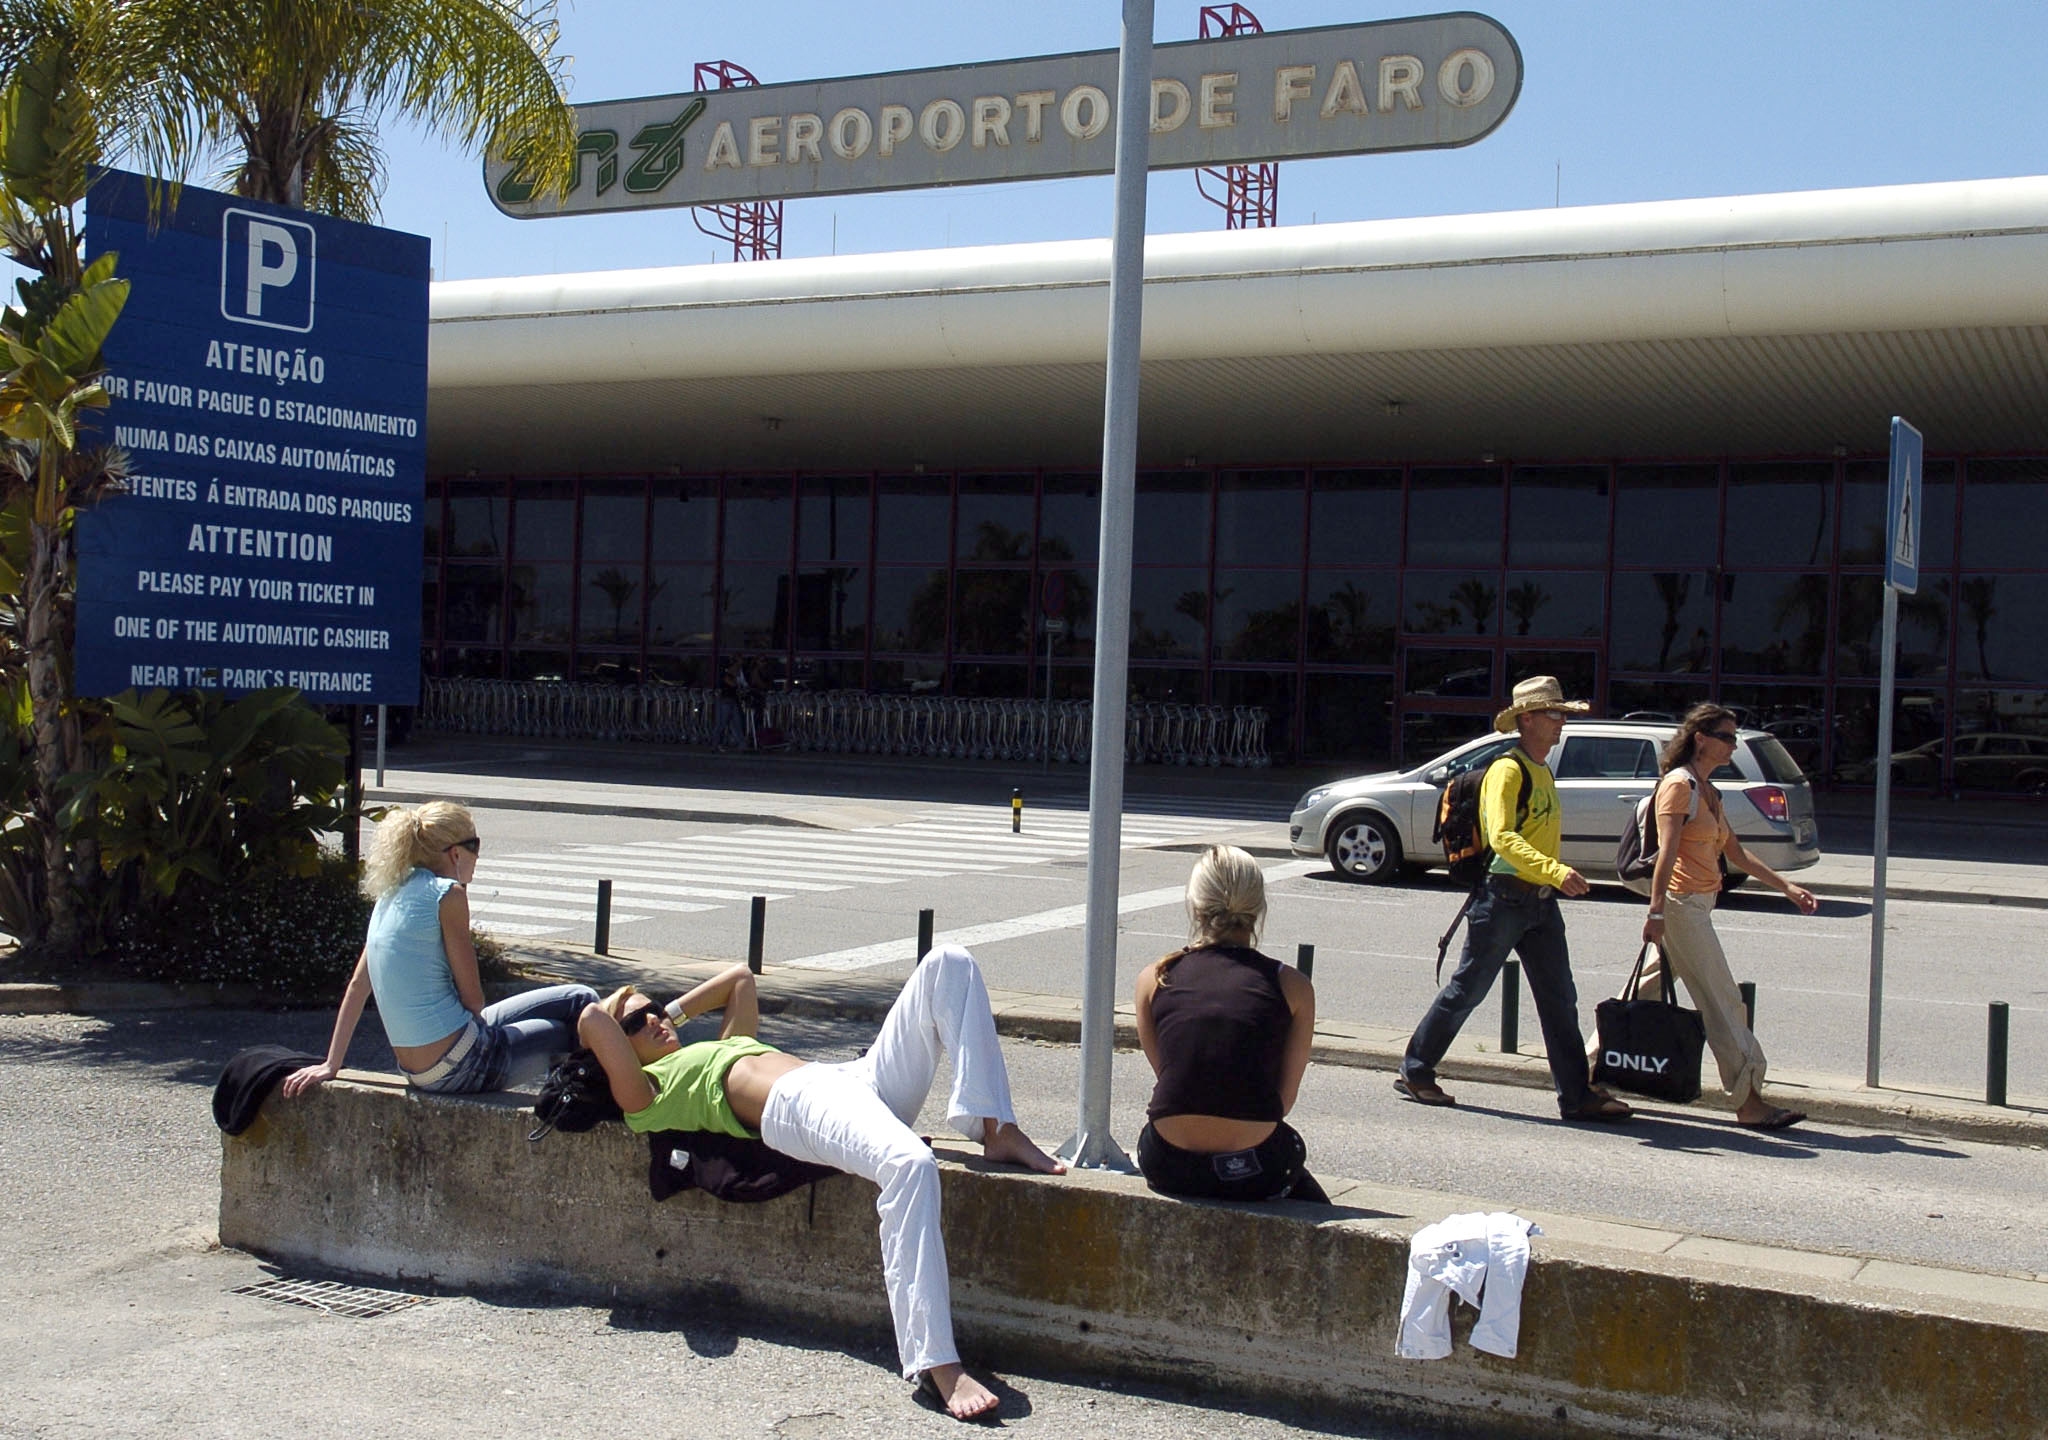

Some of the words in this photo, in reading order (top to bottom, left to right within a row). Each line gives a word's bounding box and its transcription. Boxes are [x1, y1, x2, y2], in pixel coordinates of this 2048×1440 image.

[705, 85, 1110, 169] AEROPORTO
[1149, 71, 1239, 133] DE
[1274, 46, 1496, 123] FARO
[246, 220, 297, 316] P
[205, 340, 325, 386] ATENÇÃO
[134, 379, 192, 408] FAVOR
[198, 388, 254, 416] PAGUE
[259, 397, 270, 418] O
[275, 400, 417, 438] ESTACIONAMENTO
[114, 425, 169, 452] NUMA
[174, 432, 209, 456] DAS
[214, 437, 276, 464] CAIXAS
[281, 448, 396, 478] AUTOMÁTICAS
[207, 477, 219, 504] Á
[224, 484, 301, 512] ENTRADA
[305, 493, 337, 516] DOS
[341, 497, 412, 523] PARQUES
[187, 523, 332, 562] ATTENTION
[138, 570, 204, 595] PLEASE
[209, 575, 242, 598] PAY
[247, 578, 293, 601] YOUR
[297, 582, 354, 605] TICKET
[359, 586, 375, 606] IN
[114, 615, 150, 638] ONE
[155, 618, 179, 640] OF
[184, 620, 217, 642] THE
[222, 622, 319, 647] AUTOMATIC
[323, 627, 390, 650] CASHIER
[131, 664, 179, 687] NEAR
[289, 670, 372, 692] ENTRANCE
[1605, 1050, 1669, 1073] ONLY
